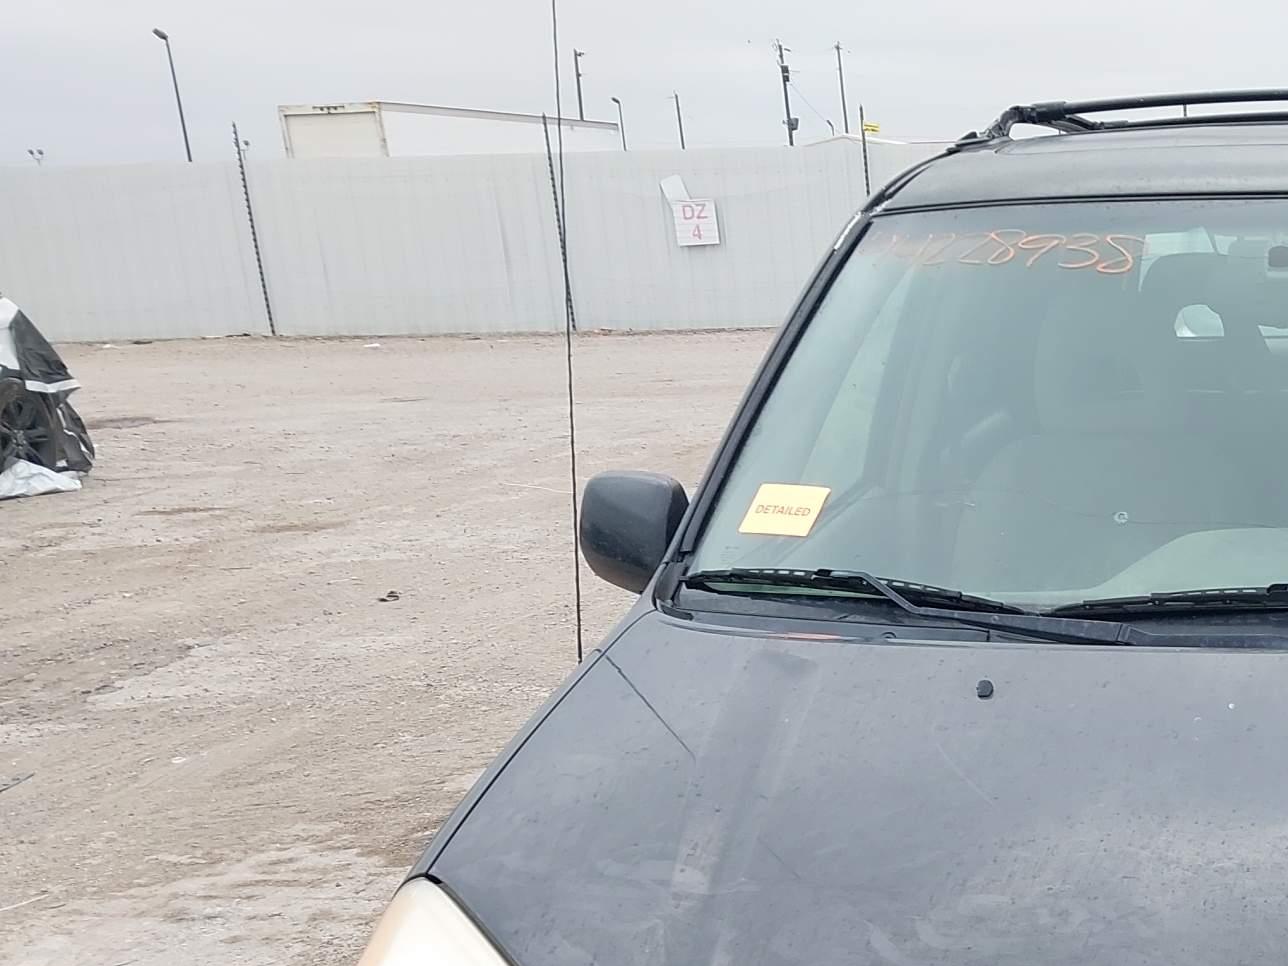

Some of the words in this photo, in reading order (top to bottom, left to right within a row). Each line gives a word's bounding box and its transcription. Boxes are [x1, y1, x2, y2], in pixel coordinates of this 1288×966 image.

[681, 203, 709, 220] DZ
[691, 223, 703, 241] 4
[754, 503, 812, 518] DETAILED
